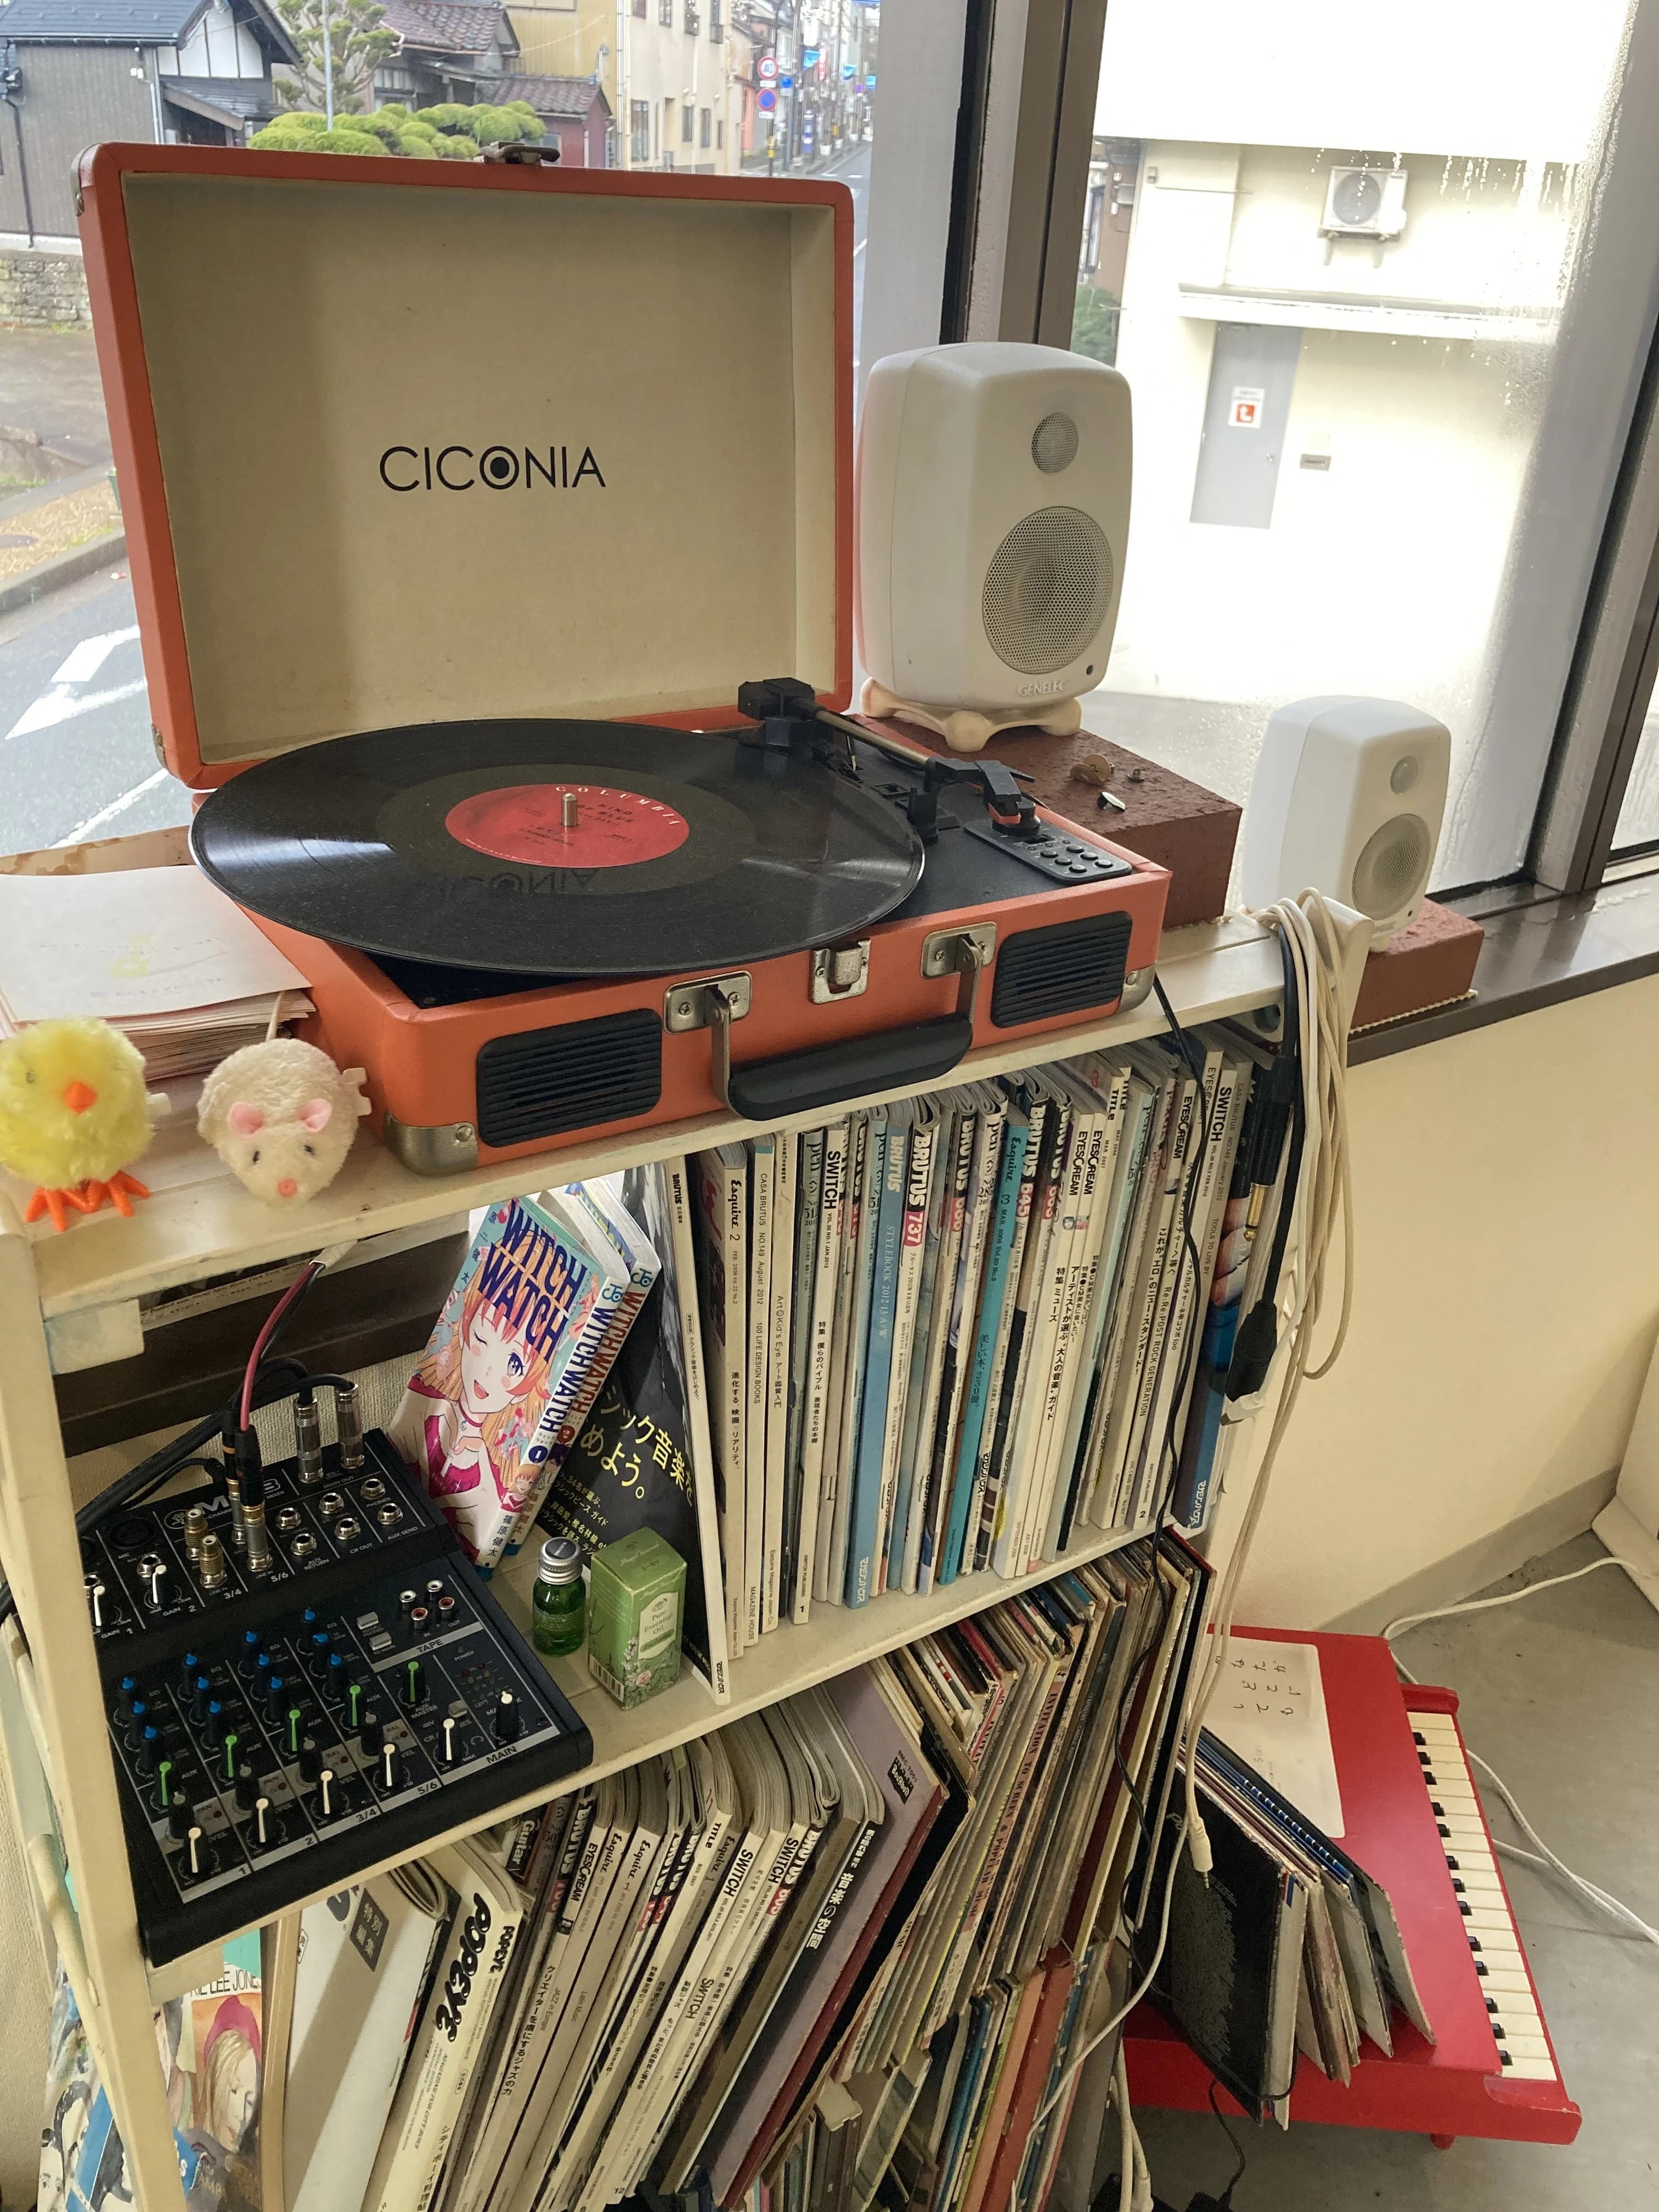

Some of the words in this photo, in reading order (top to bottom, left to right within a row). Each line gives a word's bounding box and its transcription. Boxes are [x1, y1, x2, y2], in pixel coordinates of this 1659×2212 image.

[380, 445, 606, 492] CICONIA
[1018, 680, 1066, 697] GENELEC
[556, 786, 681, 826] COLUMBIA
[1107, 1088, 1119, 1121] TITLE
[1235, 1082, 1243, 1101] CASA
[1172, 1096, 1193, 1159] EYESCREAM
[1209, 1085, 1232, 1143] SWITCH
[1229, 1103, 1239, 1131] BRUTUS
[956, 1119, 975, 1192] BRUTUS
[1021, 1106, 1046, 1178] BRUTUS
[887, 1135, 905, 1193] BRUTUS
[909, 1134, 932, 1207] BRUTUS
[1005, 1136, 1020, 1184] Esquire
[1069, 1131, 1087, 1195] EYESCREAM
[1084, 1130, 1103, 1195] EYESCREAM
[1218, 1160, 1228, 1185] January
[673, 1173, 682, 1204] BRUTUS
[760, 1173, 769, 1193] CASA
[824, 1150, 841, 1210] SWITCH
[728, 1180, 742, 1229] Esquire
[758, 1195, 768, 1226] BRUTUS
[1001, 1194, 1009, 1205] 3
[1017, 1183, 1034, 1217] 645
[906, 1211, 924, 1244] 737
[1209, 1218, 1218, 1240] TOOLS
[501, 1198, 588, 1314] WITCH
[757, 1232, 766, 1256] NO.149
[880, 1224, 897, 1282] STYLEBOOK
[1207, 1240, 1214, 1250] TO
[755, 1261, 765, 1284] August
[1052, 1266, 1067, 1286] 特集
[1203, 1266, 1210, 1274] BY
[478, 1242, 569, 1364] WATCH
[1045, 1286, 1065, 1324] ミューズ
[755, 1335, 763, 1350] LIFE
[756, 1322, 764, 1334] 100
[817, 1321, 826, 1335] 特集
[753, 1352, 763, 1378] DESIGN
[812, 1341, 825, 1390] 僕らのバイブル
[1149, 1340, 1160, 1364] ROCK
[752, 1380, 761, 1404] BOOKS
[1139, 1365, 1155, 1417] GENERATION
[1139, 1510, 1146, 1519] 2
[359, 1542, 373, 1551] OUT
[387, 1532, 402, 1541] AUX
[401, 1526, 419, 1536] SEND
[487, 1514, 514, 1558] 篠原健太
[270, 1571, 289, 1582] 5/6
[307, 1557, 321, 1565] AUX
[223, 1589, 242, 1600] 3/4
[748, 1586, 757, 1617] MAGAZINE
[162, 1606, 181, 1616] GAIN
[644, 1613, 673, 1634] Essential
[651, 1609, 667, 1621] Pure
[100, 1628, 120, 1639] GAIN
[416, 1638, 444, 1654] TAPE
[652, 1626, 664, 1635] Oil
[454, 1650, 475, 1661] POWER
[366, 1694, 381, 1703] AUX
[307, 1718, 323, 1728] AUX
[1029, 1692, 1058, 1754] INVITATION
[486, 1745, 517, 1764] MAIN
[1023, 1760, 1033, 1777] TO
[417, 1781, 438, 1796] 5/6
[1006, 1781, 1025, 1820] SCREEN
[356, 1808, 377, 1822] 3/4
[305, 1837, 314, 1846] 2
[514, 1820, 535, 1866] Guitar
[561, 1809, 591, 1874] BRUTUS
[705, 1822, 722, 1849] TITLE
[600, 1833, 622, 1873] Esquire
[628, 1839, 650, 1879] Esquire
[713, 1835, 736, 1872] Esquire
[768, 1837, 799, 1884] SWITCH
[784, 1830, 821, 1884] BRUTUS
[237, 1866, 249, 1876] 1
[571, 1842, 598, 1901] EYESCREAM
[723, 1848, 754, 1898] SWITCH
[363, 1903, 383, 1937] 特別
[805, 1871, 854, 1950] 音楽の空間
[491, 1925, 516, 1973] POPEYE
[436, 1892, 491, 2043] POPEYE
[550, 1988, 561, 2004] JAZZ
[685, 1978, 714, 2020] SWITCH
